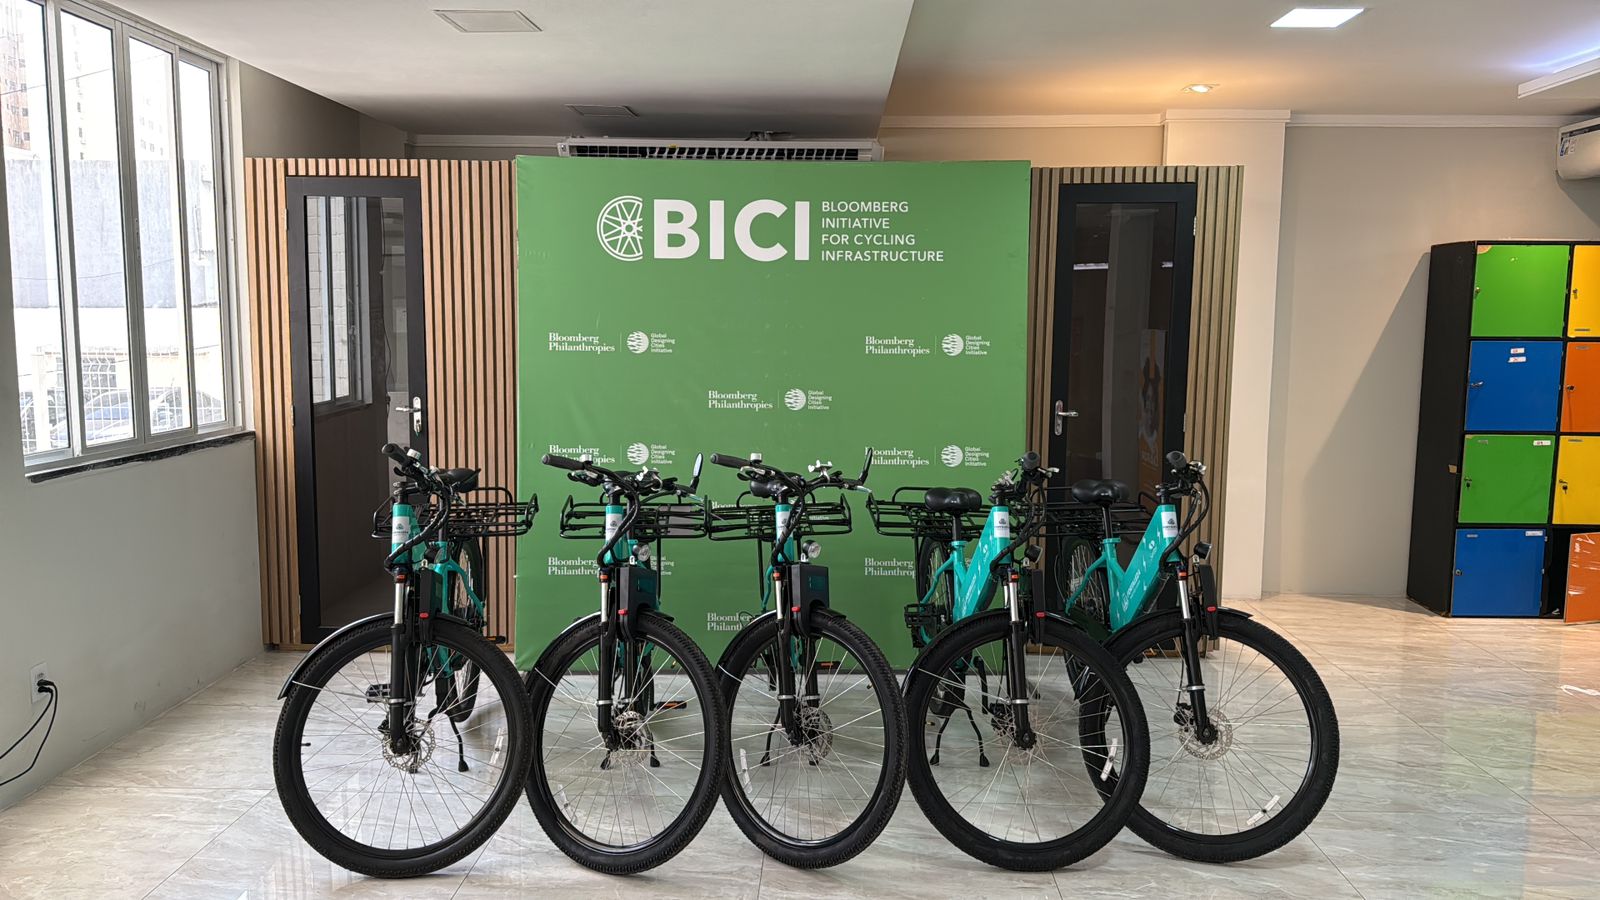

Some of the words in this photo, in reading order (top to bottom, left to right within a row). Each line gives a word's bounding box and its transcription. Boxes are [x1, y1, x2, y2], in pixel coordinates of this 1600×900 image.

[821, 200, 909, 213] BLOOMBERG
[821, 217, 890, 229] INITIATIVE
[653, 198, 810, 262] BICI
[821, 233, 850, 246] FOR
[853, 233, 916, 246] CYCLING
[821, 250, 944, 262] INFRASTRUCTURE
[549, 332, 600, 344] Bloomberg
[865, 336, 914, 347] Bloomberg
[549, 342, 615, 354] Philanthropies
[865, 345, 930, 357] Philanthropies
[708, 390, 758, 402] Bloomberg
[708, 400, 773, 412] Philanthropies
[549, 444, 600, 456] Bloomberg
[871, 456, 930, 468] hilanthropies
[864, 557, 914, 569] Bloomberg
